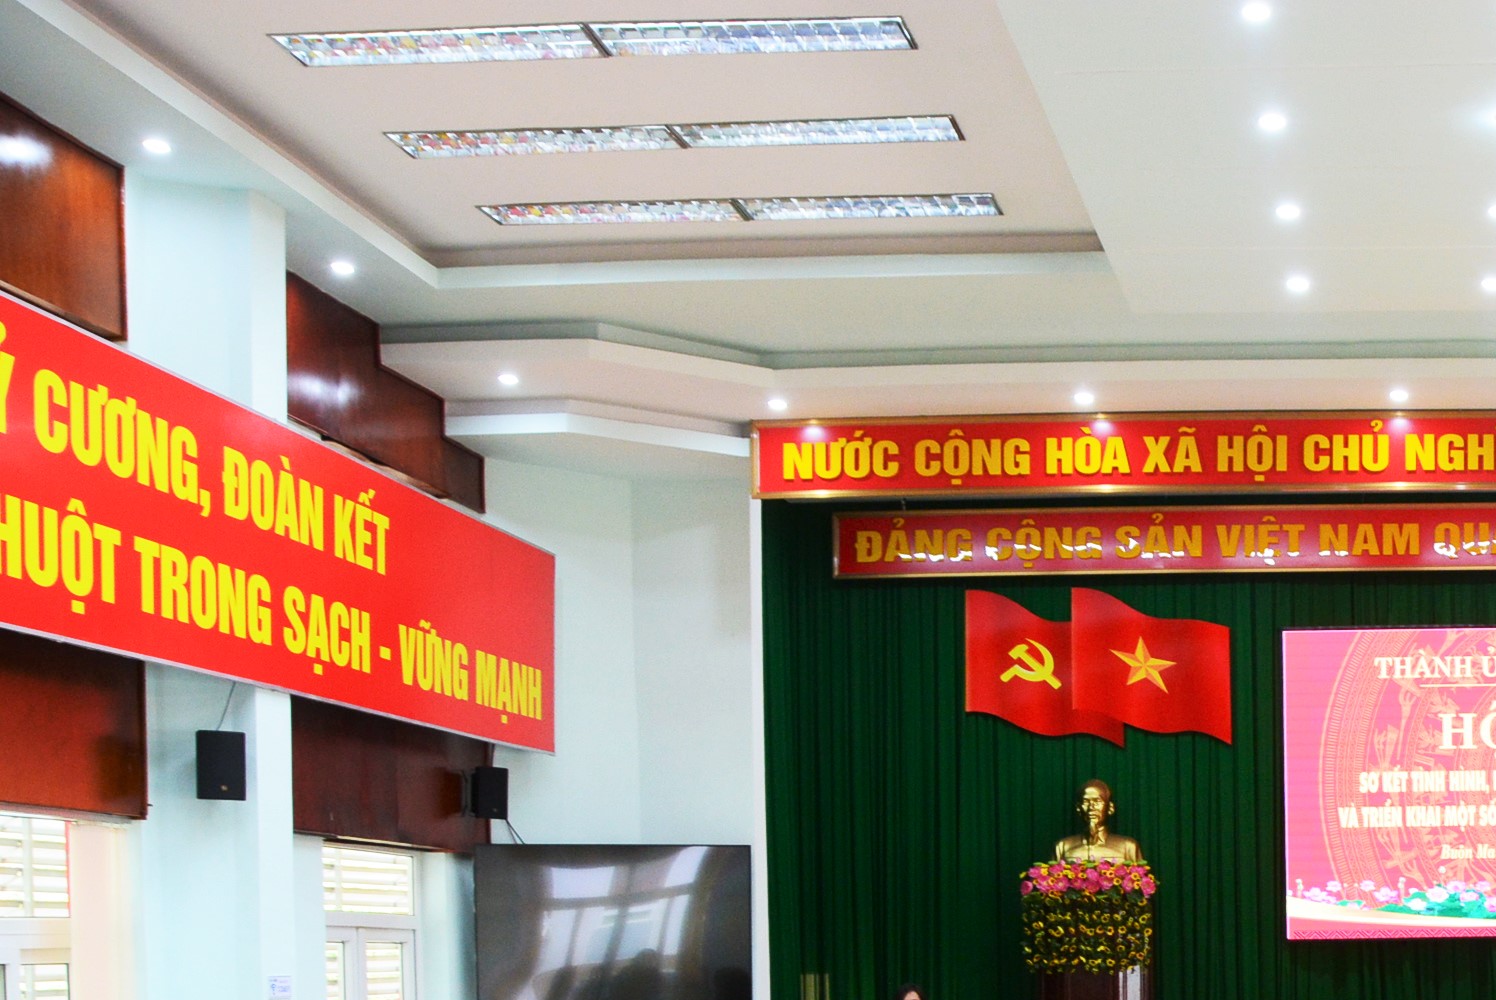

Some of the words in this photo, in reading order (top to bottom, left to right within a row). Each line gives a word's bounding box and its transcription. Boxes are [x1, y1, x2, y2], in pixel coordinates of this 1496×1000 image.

[34, 370, 210, 516] CƯƠNG,
[223, 447, 324, 550] ĐOÀN
[335, 489, 389, 574] KẾT
[783, 432, 899, 480] NƯỚC
[915, 429, 1031, 485] CỘNG
[1046, 427, 1131, 474] HÒA
[1142, 427, 1202, 473] XÃ
[1217, 425, 1287, 482] HỘI
[1303, 417, 1390, 472] CHỦ
[855, 518, 972, 563] ĐẢNG
[985, 519, 1103, 567] CỘNG
[1115, 513, 1202, 558] SẢN
[1216, 516, 1305, 564] VIỆT
[1320, 524, 1420, 556] NAM
[134, 536, 272, 645] TRONG
[284, 586, 370, 674] SẠCH
[399, 620, 468, 700] VỮNG
[476, 651, 542, 723] MẠNH
[1374, 649, 1473, 679] THÀNH
